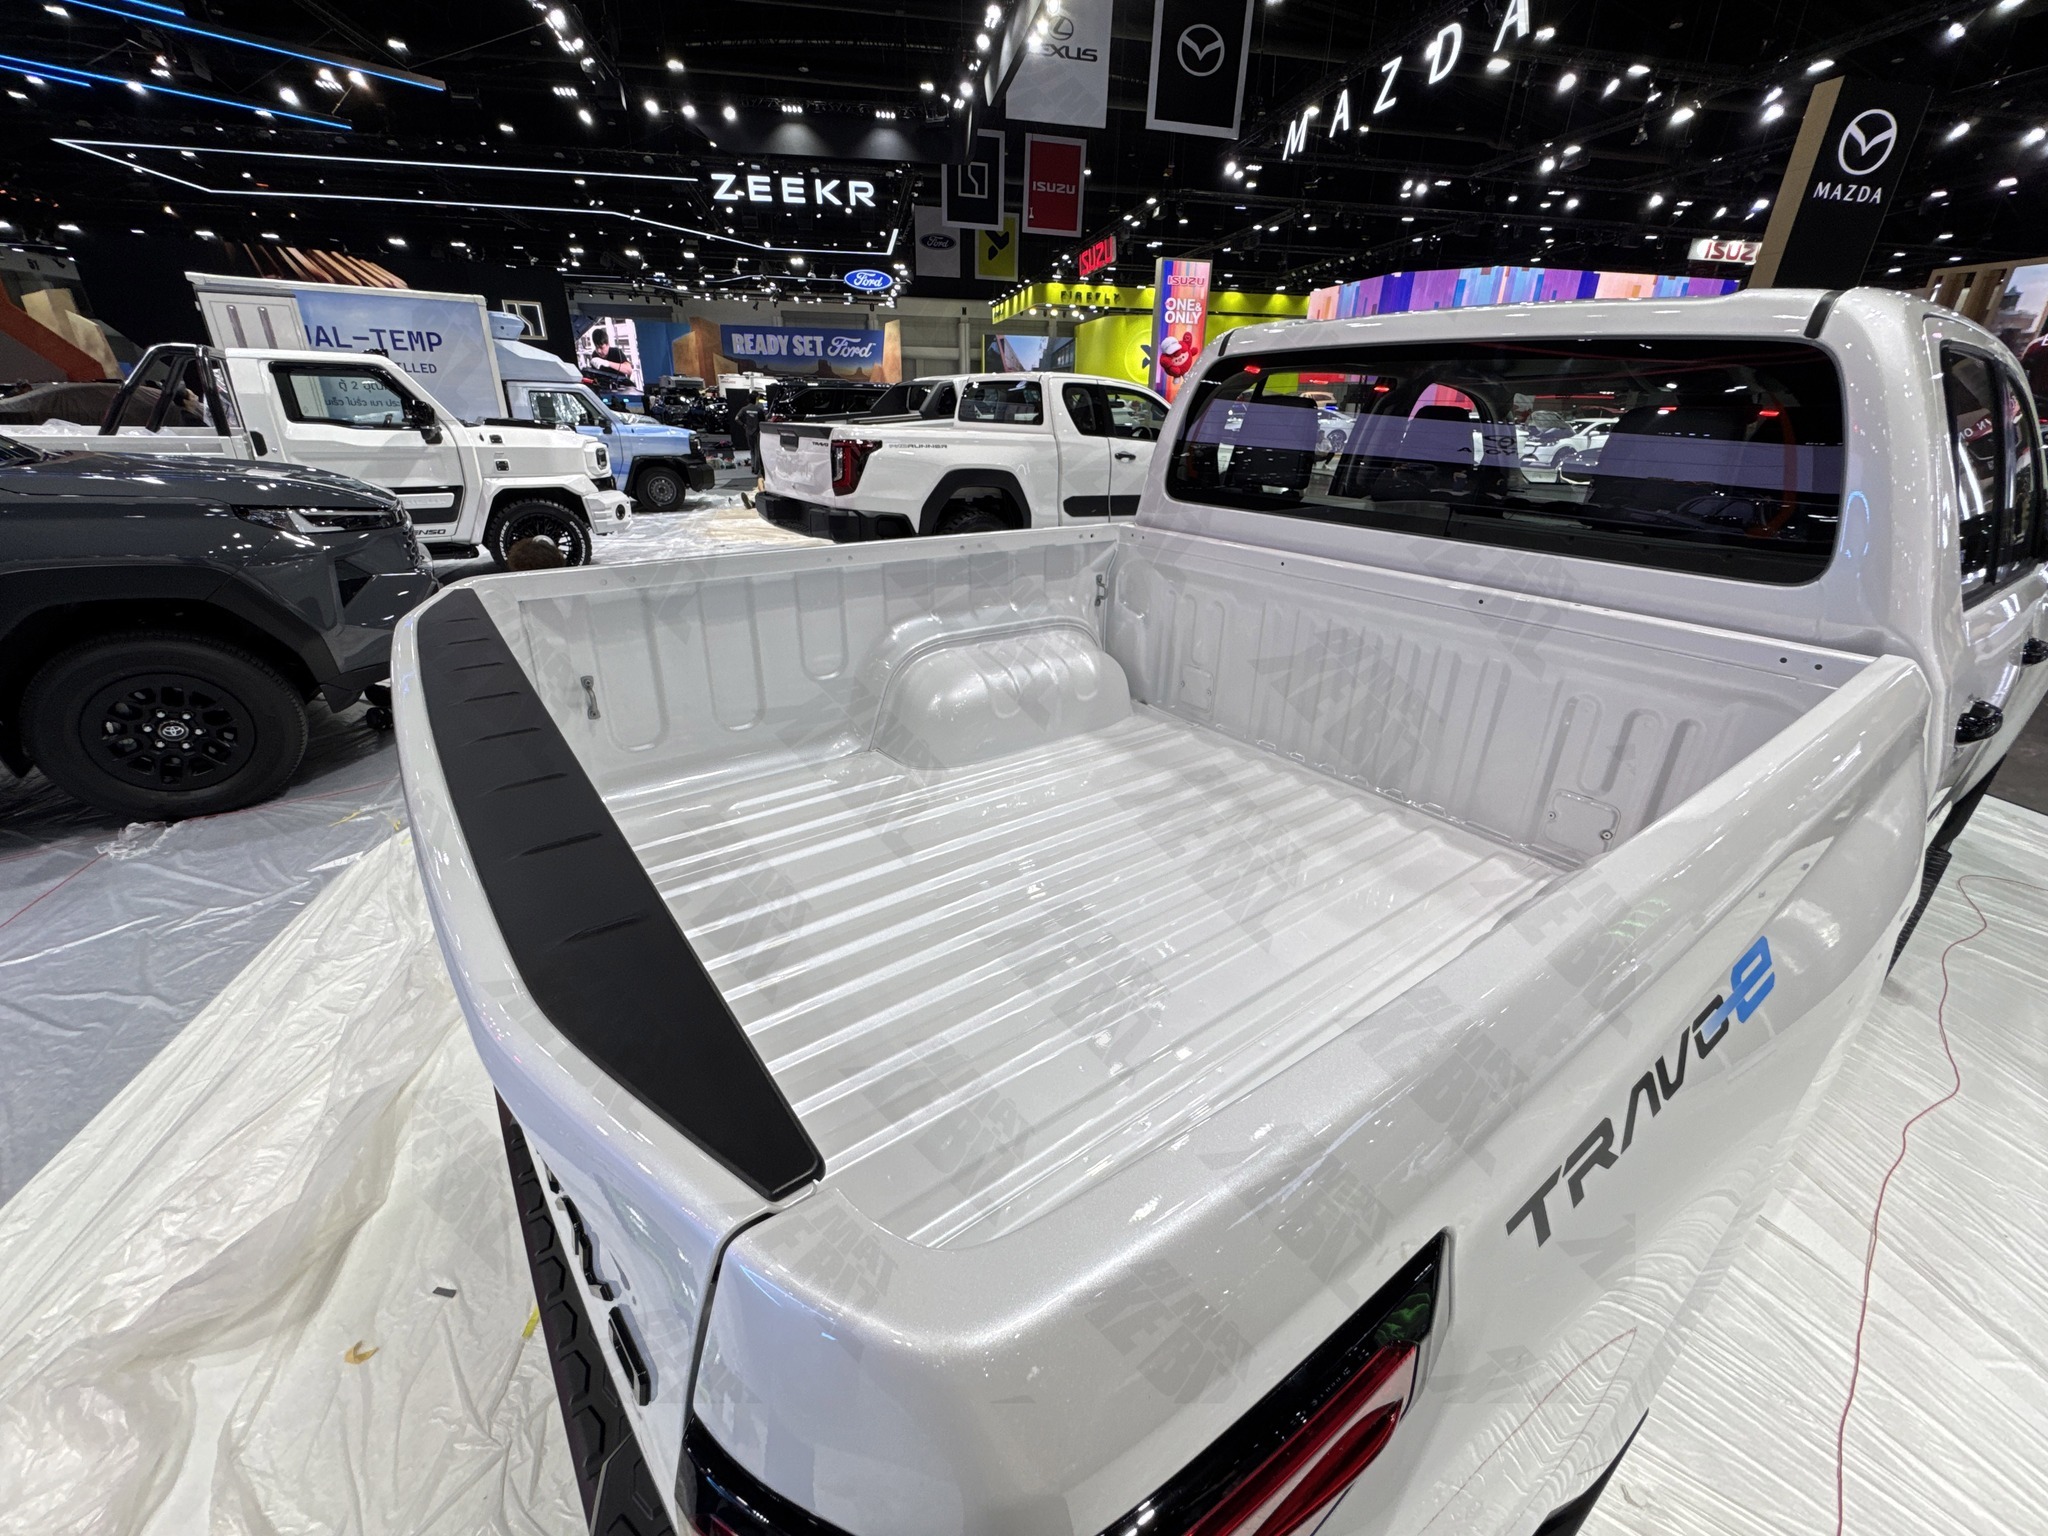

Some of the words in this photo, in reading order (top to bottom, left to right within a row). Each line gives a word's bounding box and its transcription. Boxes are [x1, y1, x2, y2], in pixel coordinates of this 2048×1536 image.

[1029, 43, 1098, 62] EXUS
[1282, 0, 1530, 161] MAZDA
[710, 173, 876, 207] ZEEKR
[1032, 180, 1076, 195] ISUZU
[1812, 181, 1882, 204] MAZDA
[926, 235, 950, 248] Ford
[1079, 235, 1114, 276] ISUZU
[1704, 242, 1759, 261] ISUZ
[853, 272, 883, 287] Ford
[1167, 275, 1205, 286] ISUZU
[1060, 291, 1120, 305] FIREFLY
[1164, 311, 1202, 324] ONLY
[731, 333, 789, 356] READY
[792, 335, 824, 357] SET
[827, 336, 873, 358] Ford
